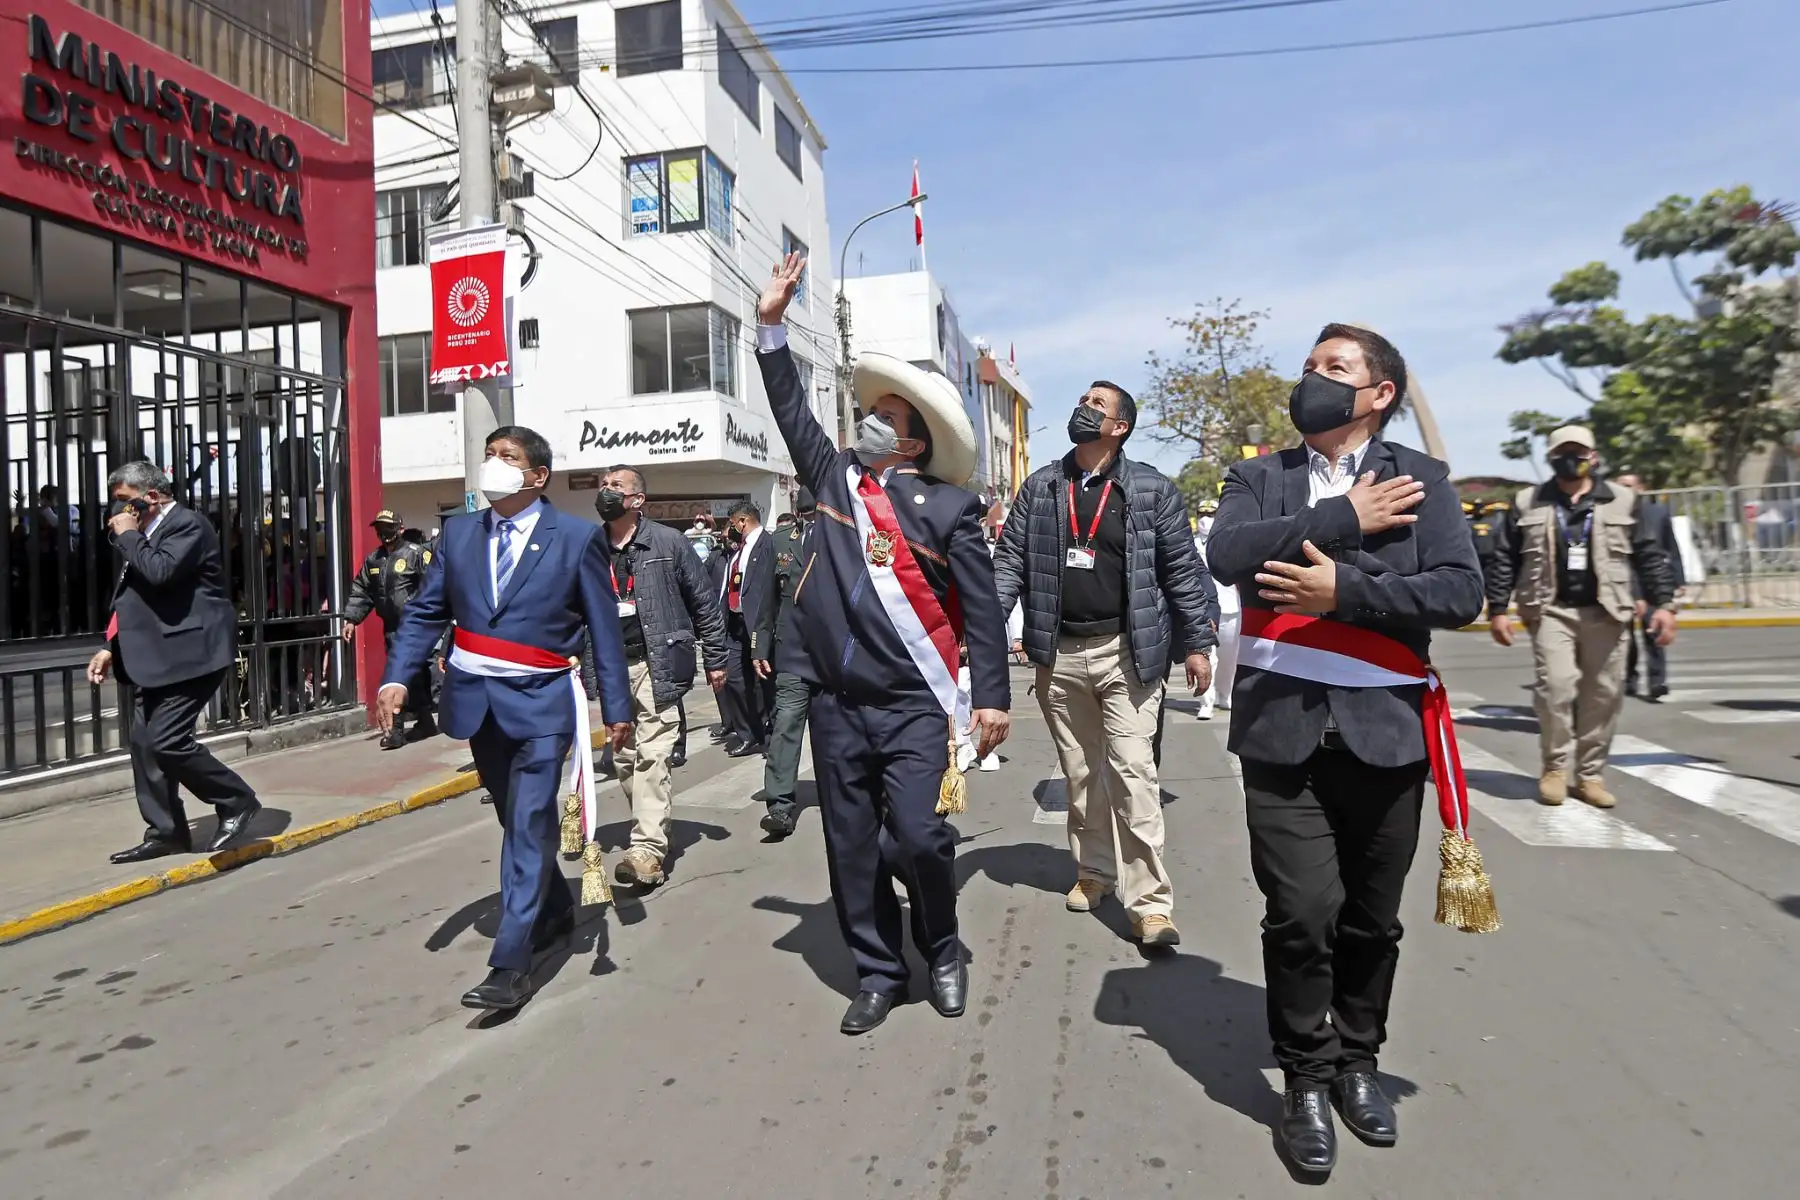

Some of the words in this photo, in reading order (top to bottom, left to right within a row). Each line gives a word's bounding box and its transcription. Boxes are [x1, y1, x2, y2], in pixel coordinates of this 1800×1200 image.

[28, 13, 301, 173] MINISTERIO
[14, 136, 128, 194] DIRECCIÓN
[135, 180, 286, 247] DESCONCENTRADA
[288, 237, 308, 258] DE
[21, 72, 97, 143] DE
[112, 114, 304, 225] CULTURA
[93, 191, 178, 233] CULTURA
[183, 219, 206, 244] DE
[210, 230, 260, 264] TACNA
[447, 330, 491, 341] BICENTENARIO
[579, 417, 704, 452] Piamonte
